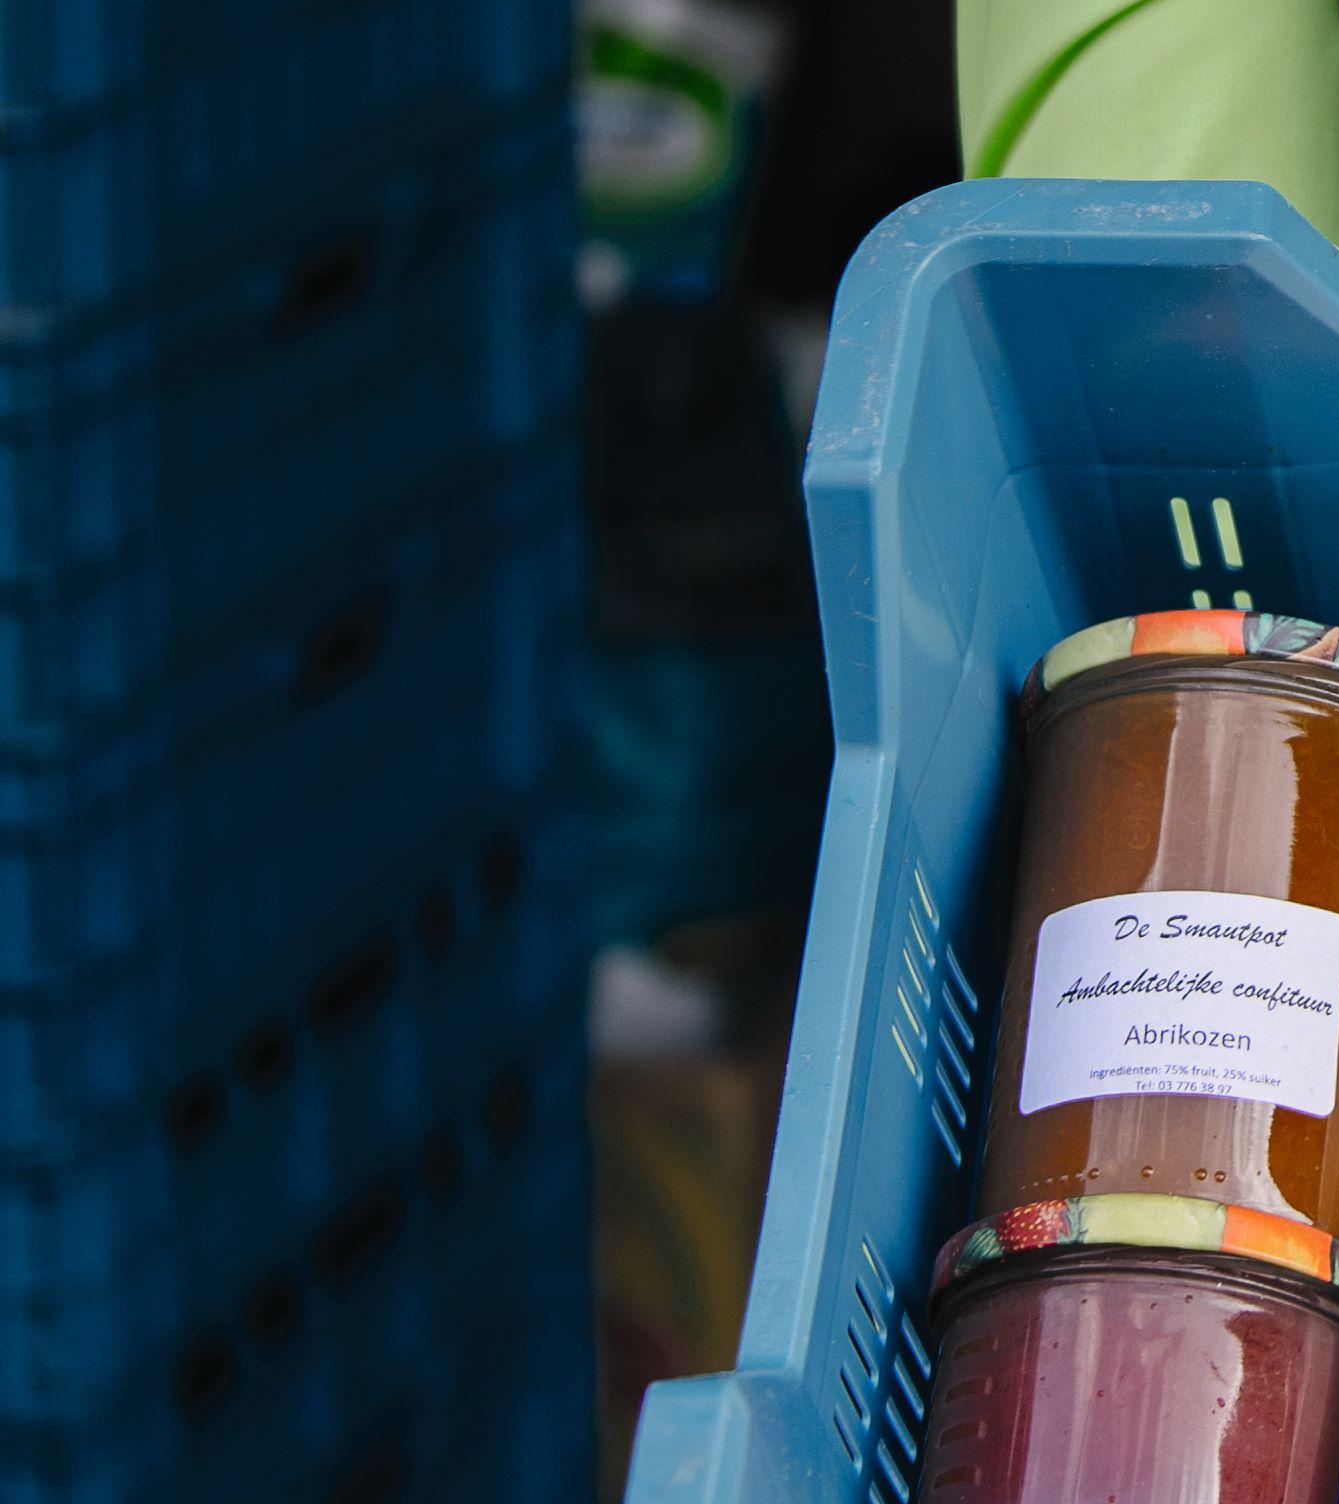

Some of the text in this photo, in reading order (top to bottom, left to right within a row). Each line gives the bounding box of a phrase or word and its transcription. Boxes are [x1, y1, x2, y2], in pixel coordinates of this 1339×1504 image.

[1114, 914, 1288, 948] De Smautpot
[1056, 968, 1334, 1016] Ambachtelijke confituur
[1124, 1024, 1252, 1051] Abrikozen
[1158, 1080, 1172, 1091] 03
[1176, 1080, 1197, 1092] 776
[1201, 1081, 1215, 1093] 38
[1218, 1083, 1232, 1095] 97
[1165, 1064, 1189, 1075] 75%
[1191, 1065, 1219, 1078] fruit,
[1223, 1068, 1246, 1081] 25%
[1249, 1074, 1281, 1087] suiker
